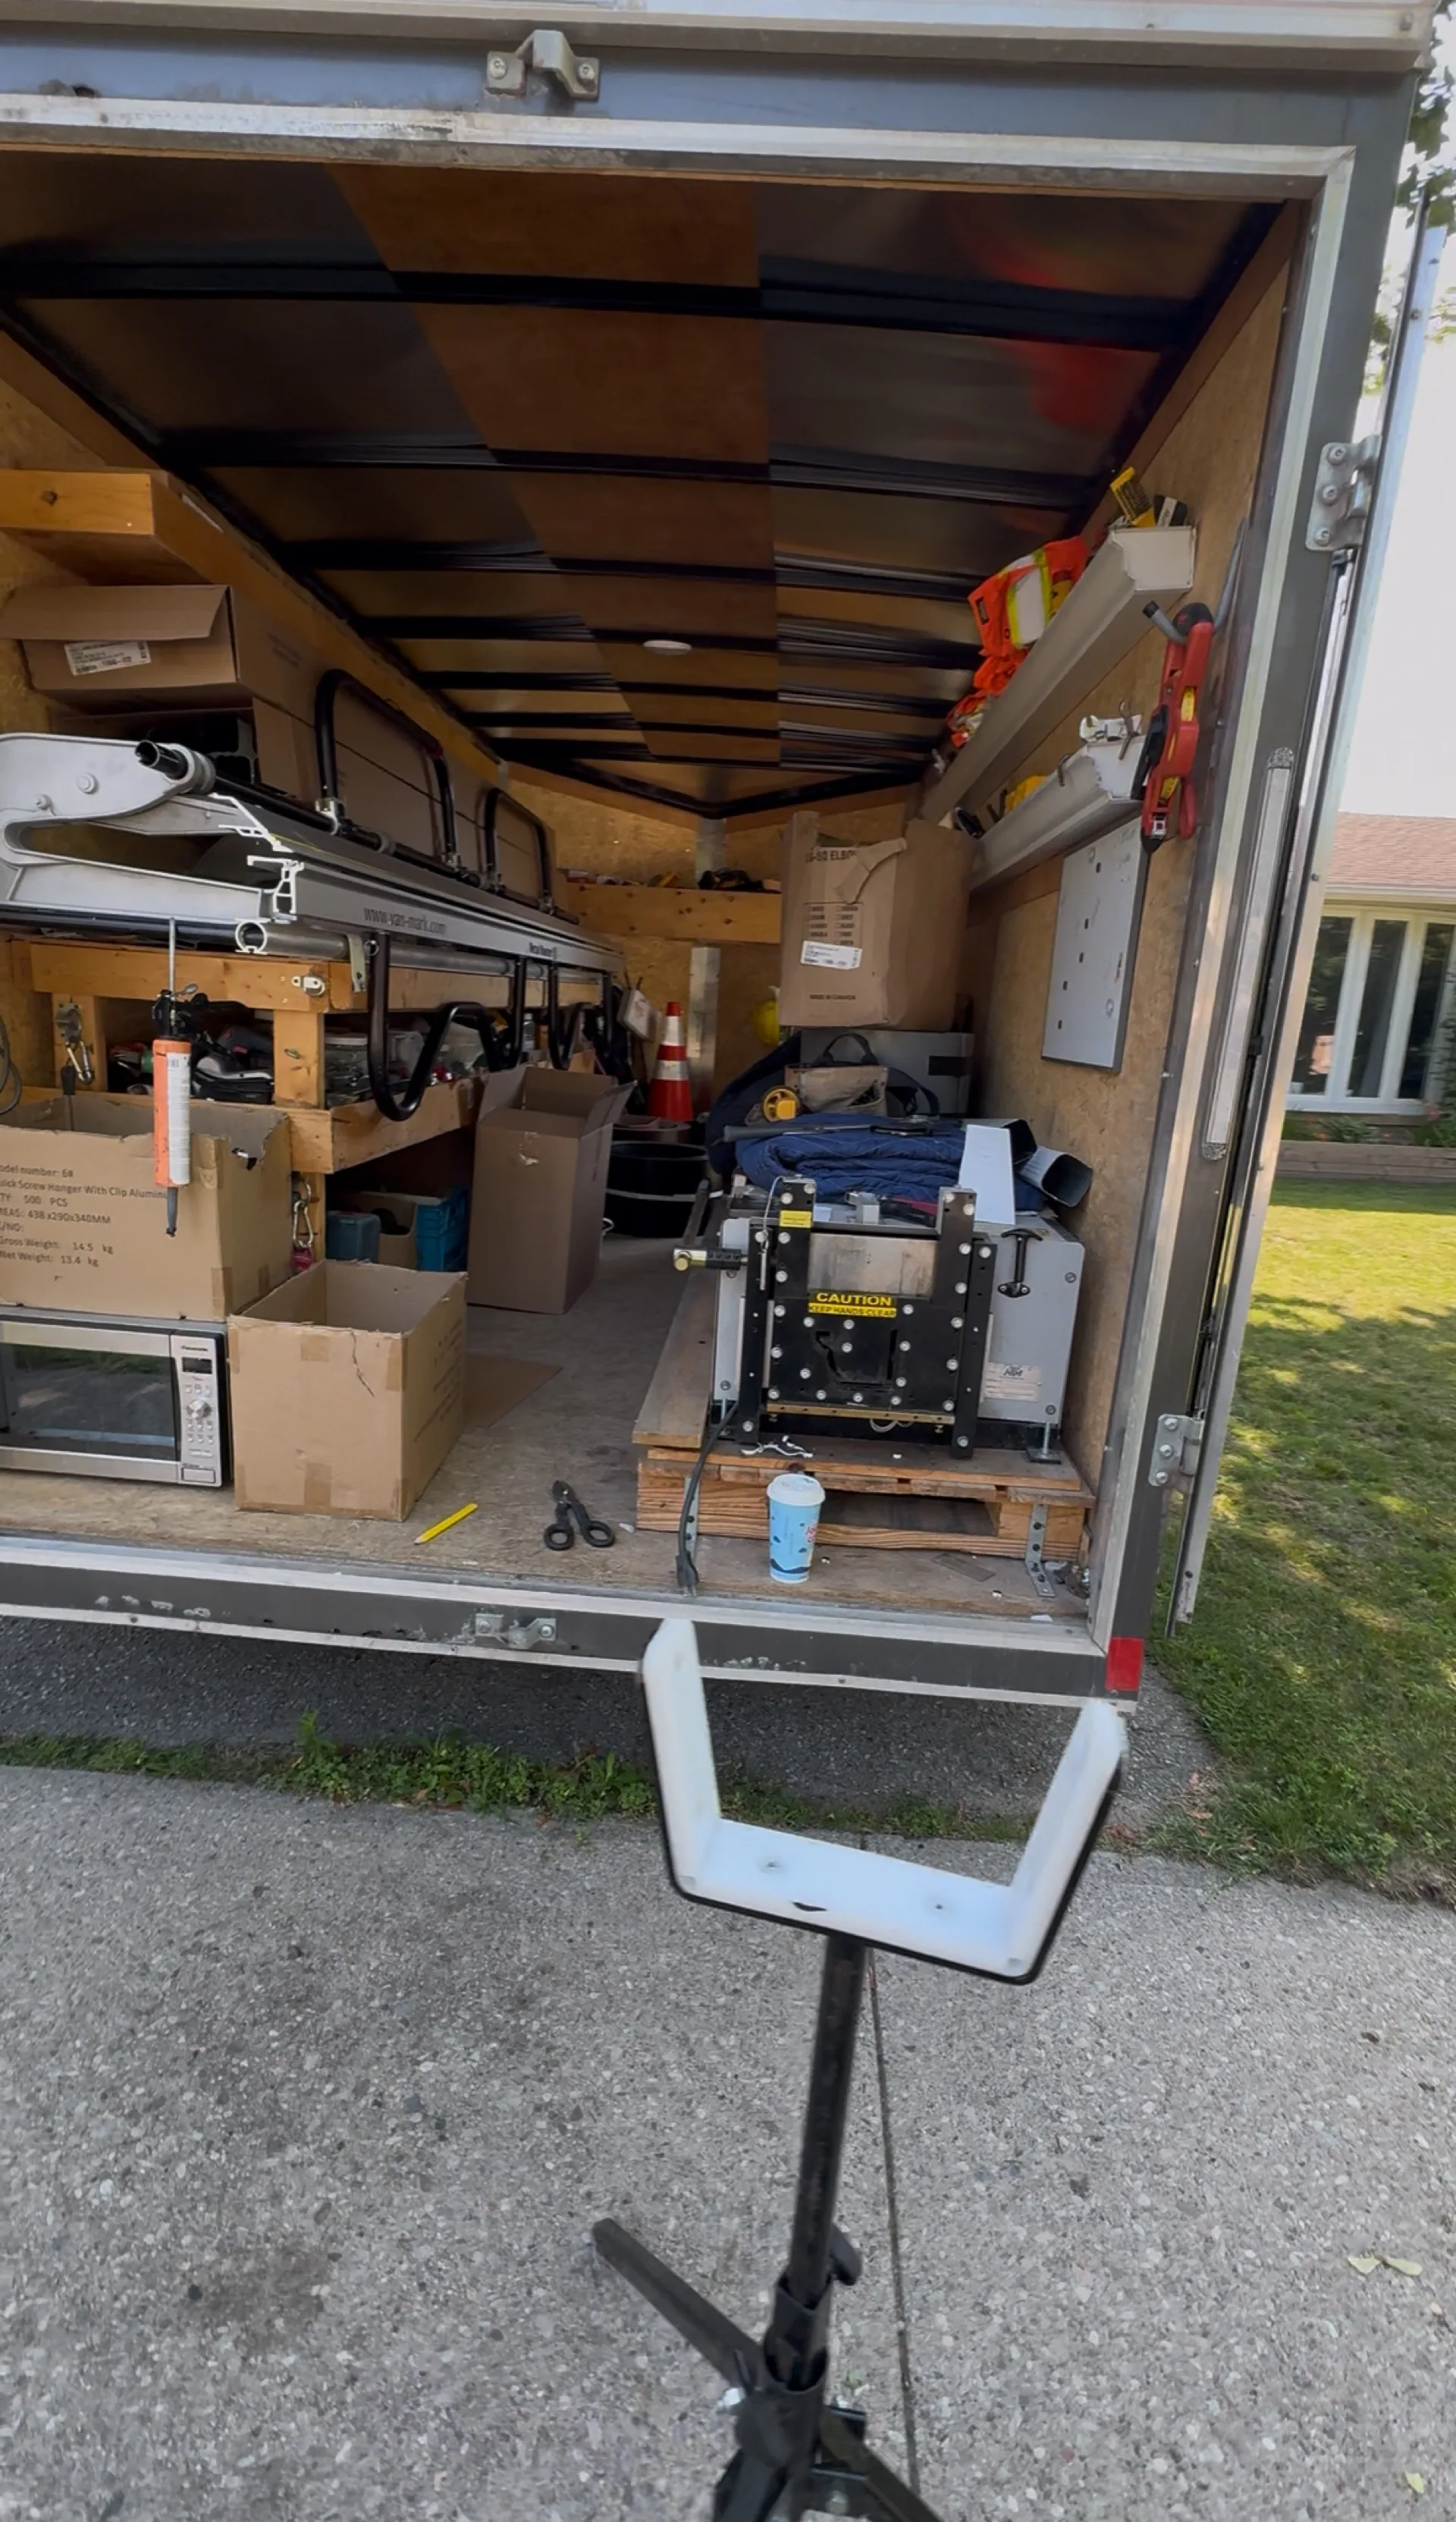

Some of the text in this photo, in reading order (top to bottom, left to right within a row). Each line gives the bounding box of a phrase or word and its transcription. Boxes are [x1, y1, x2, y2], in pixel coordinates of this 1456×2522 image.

[0, 1164, 18, 1173] odel
[19, 1179, 46, 1191] Screw
[48, 1183, 82, 1195] Hanger
[83, 1185, 107, 1195] With
[109, 1186, 127, 1198] Clip
[24, 1195, 42, 1204] 500
[50, 1197, 68, 1208] PCS
[73, 1242, 93, 1252] 14.5
[102, 1244, 114, 1255] kg
[61, 1255, 81, 1265] 13.4
[88, 1257, 99, 1267] kg
[816, 1292, 892, 1306] CAUTION
[833, 1307, 865, 1315] HANDS
[867, 1308, 896, 1317] CLEAR
